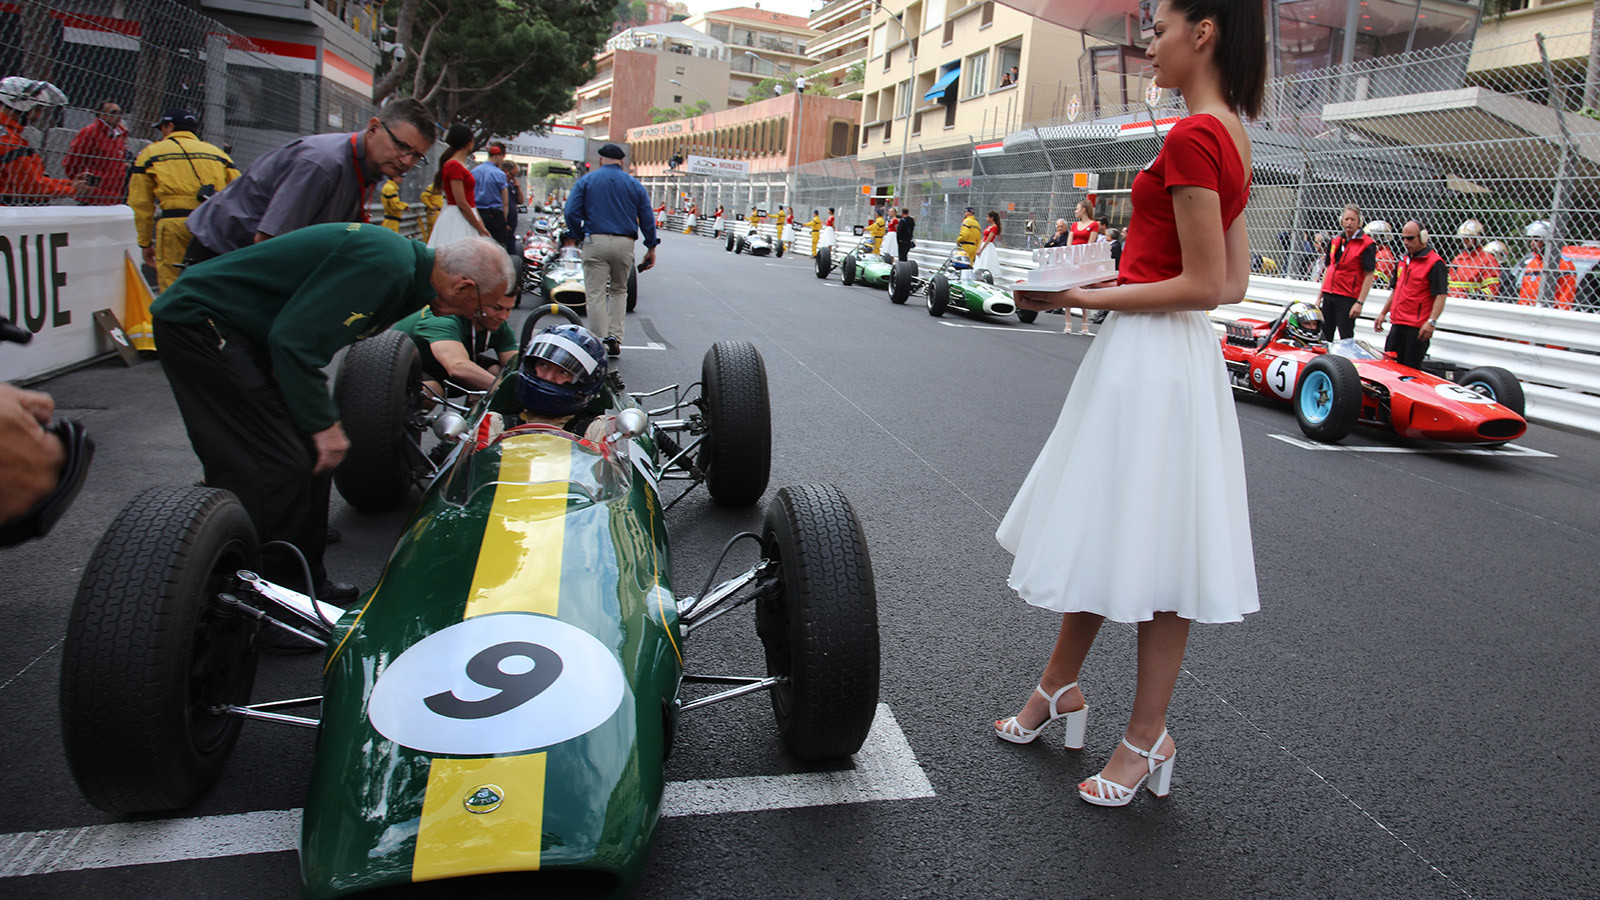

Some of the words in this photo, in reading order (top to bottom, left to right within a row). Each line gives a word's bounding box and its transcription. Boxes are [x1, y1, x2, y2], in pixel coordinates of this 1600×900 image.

[505, 143, 521, 153] PRIX
[521, 144, 564, 158] HISTORIQUE
[719, 161, 743, 171] MONACO
[1275, 360, 1290, 392] 5
[1448, 386, 1483, 400] 5
[423, 641, 564, 720] 9
